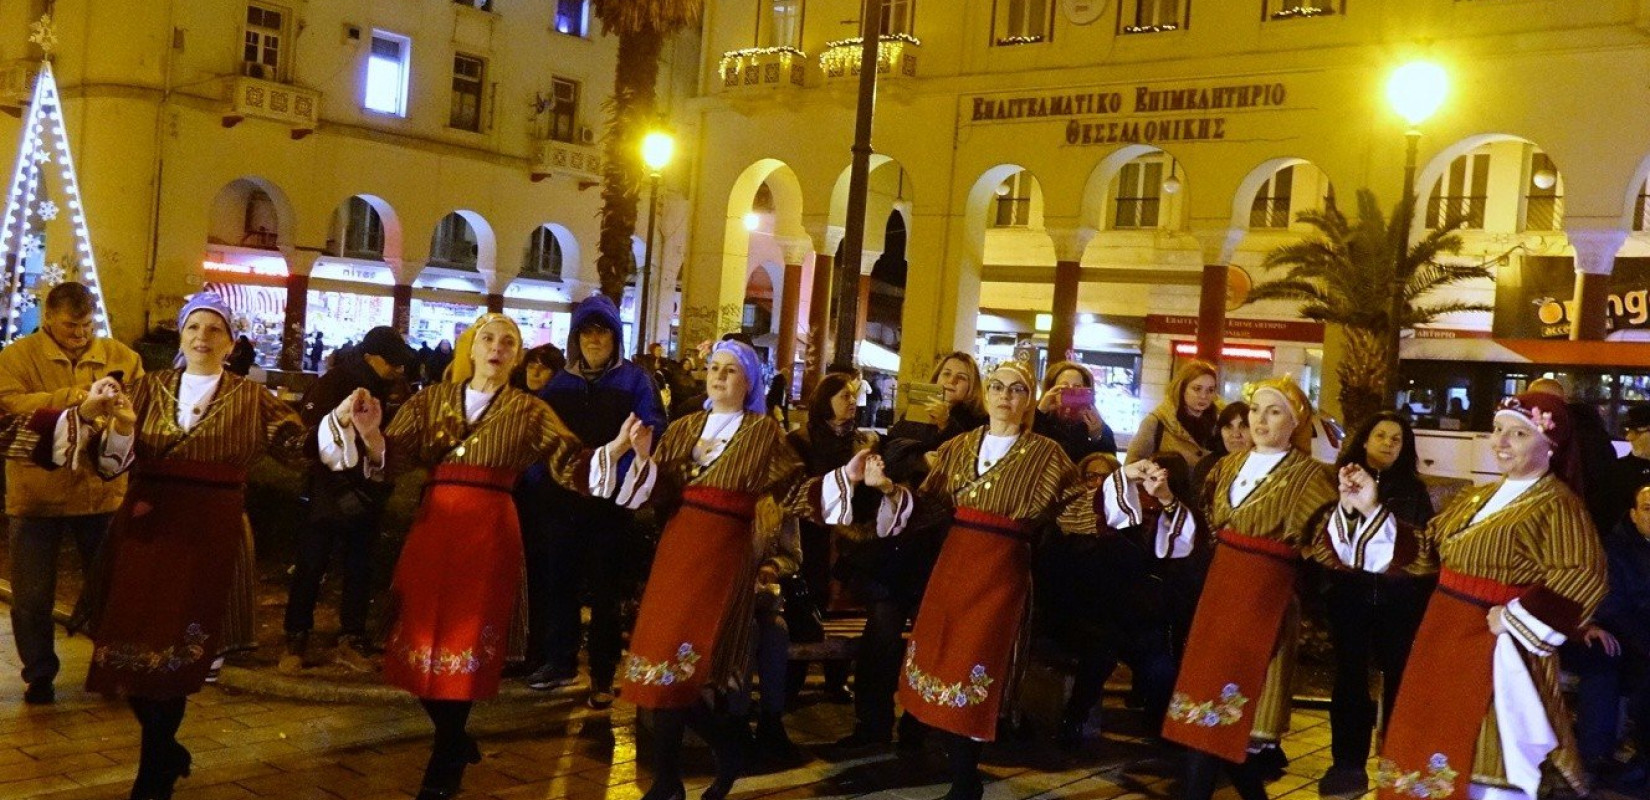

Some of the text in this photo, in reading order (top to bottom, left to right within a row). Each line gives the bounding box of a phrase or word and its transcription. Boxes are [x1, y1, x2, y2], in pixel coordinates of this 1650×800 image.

[972, 82, 1286, 121] ΕΠΑΓΓΕΛΜΑΤΙΚΟ ΕΠΙΜΕΛΗΤΗΡΙΟ
[1065, 117, 1226, 145] ΘΕΣΣΑΛΟΝΙΚΗΣ
